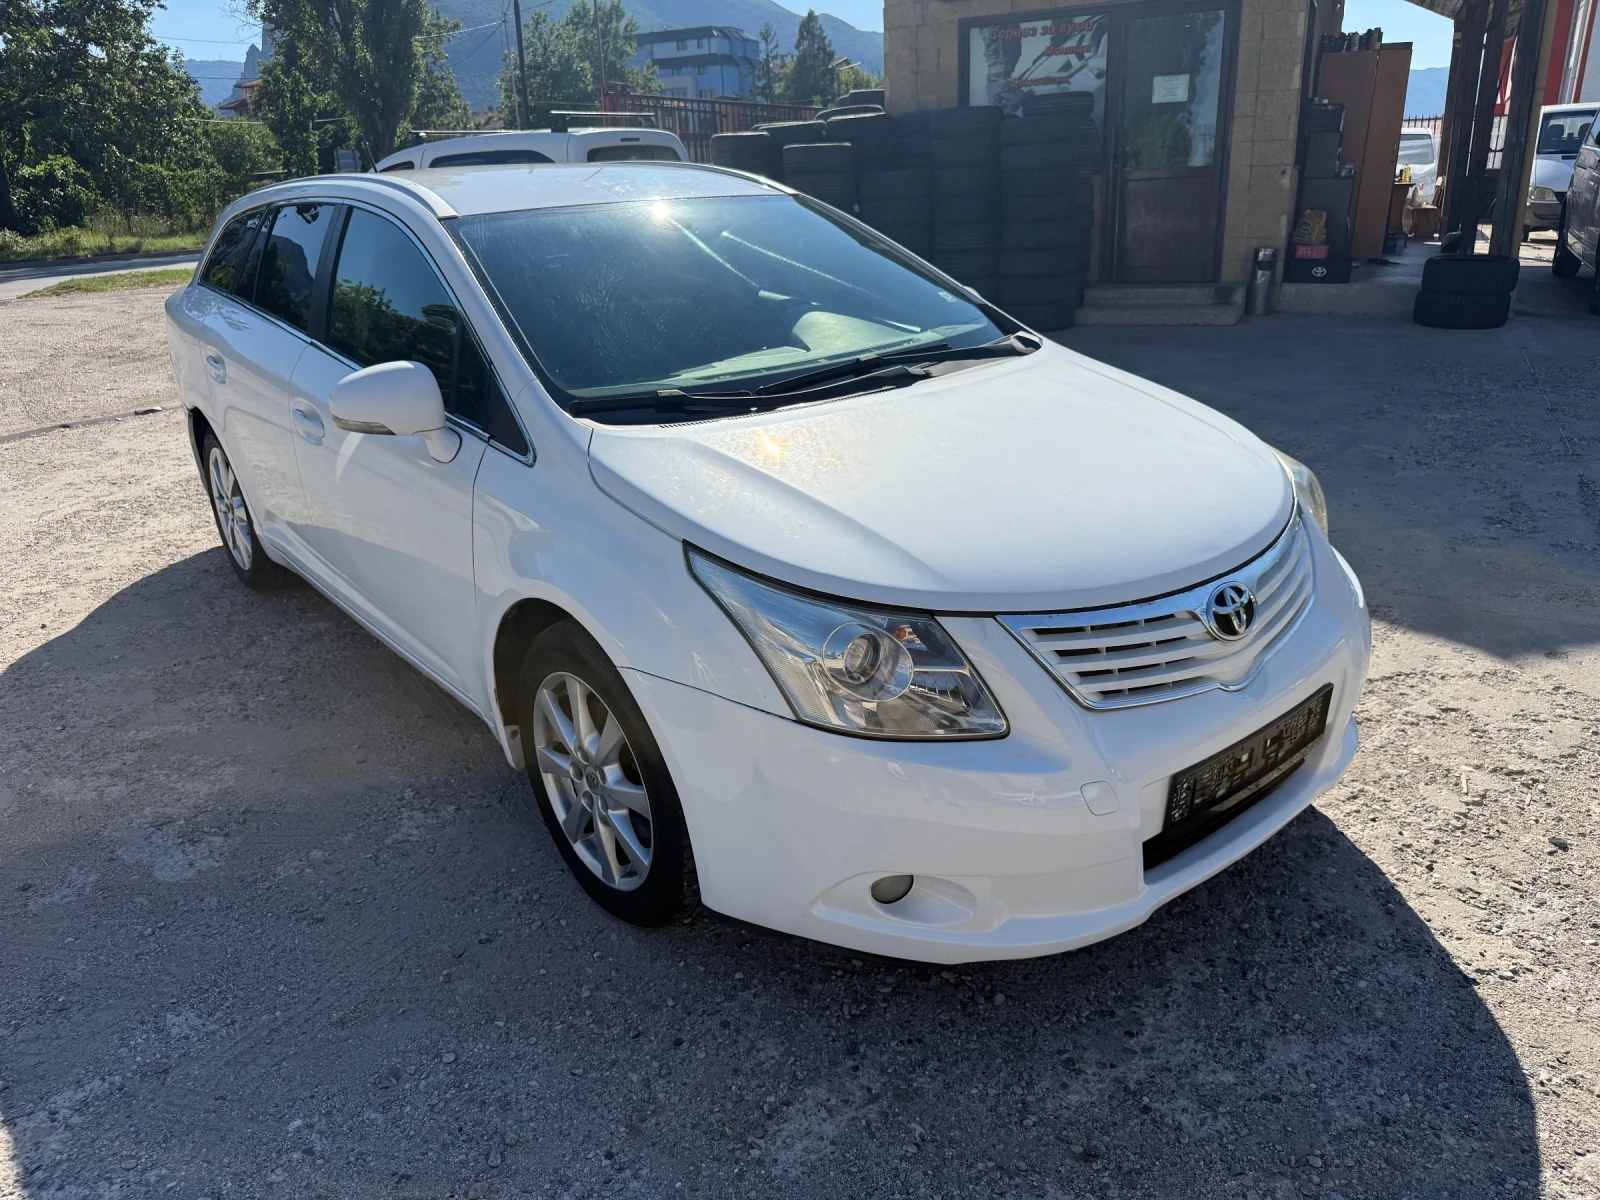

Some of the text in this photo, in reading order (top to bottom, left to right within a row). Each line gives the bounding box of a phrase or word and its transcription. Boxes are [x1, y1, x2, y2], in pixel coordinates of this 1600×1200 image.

[989, 20, 1094, 40] Сервиз за гуми
[1044, 44, 1092, 56] Монтаж
